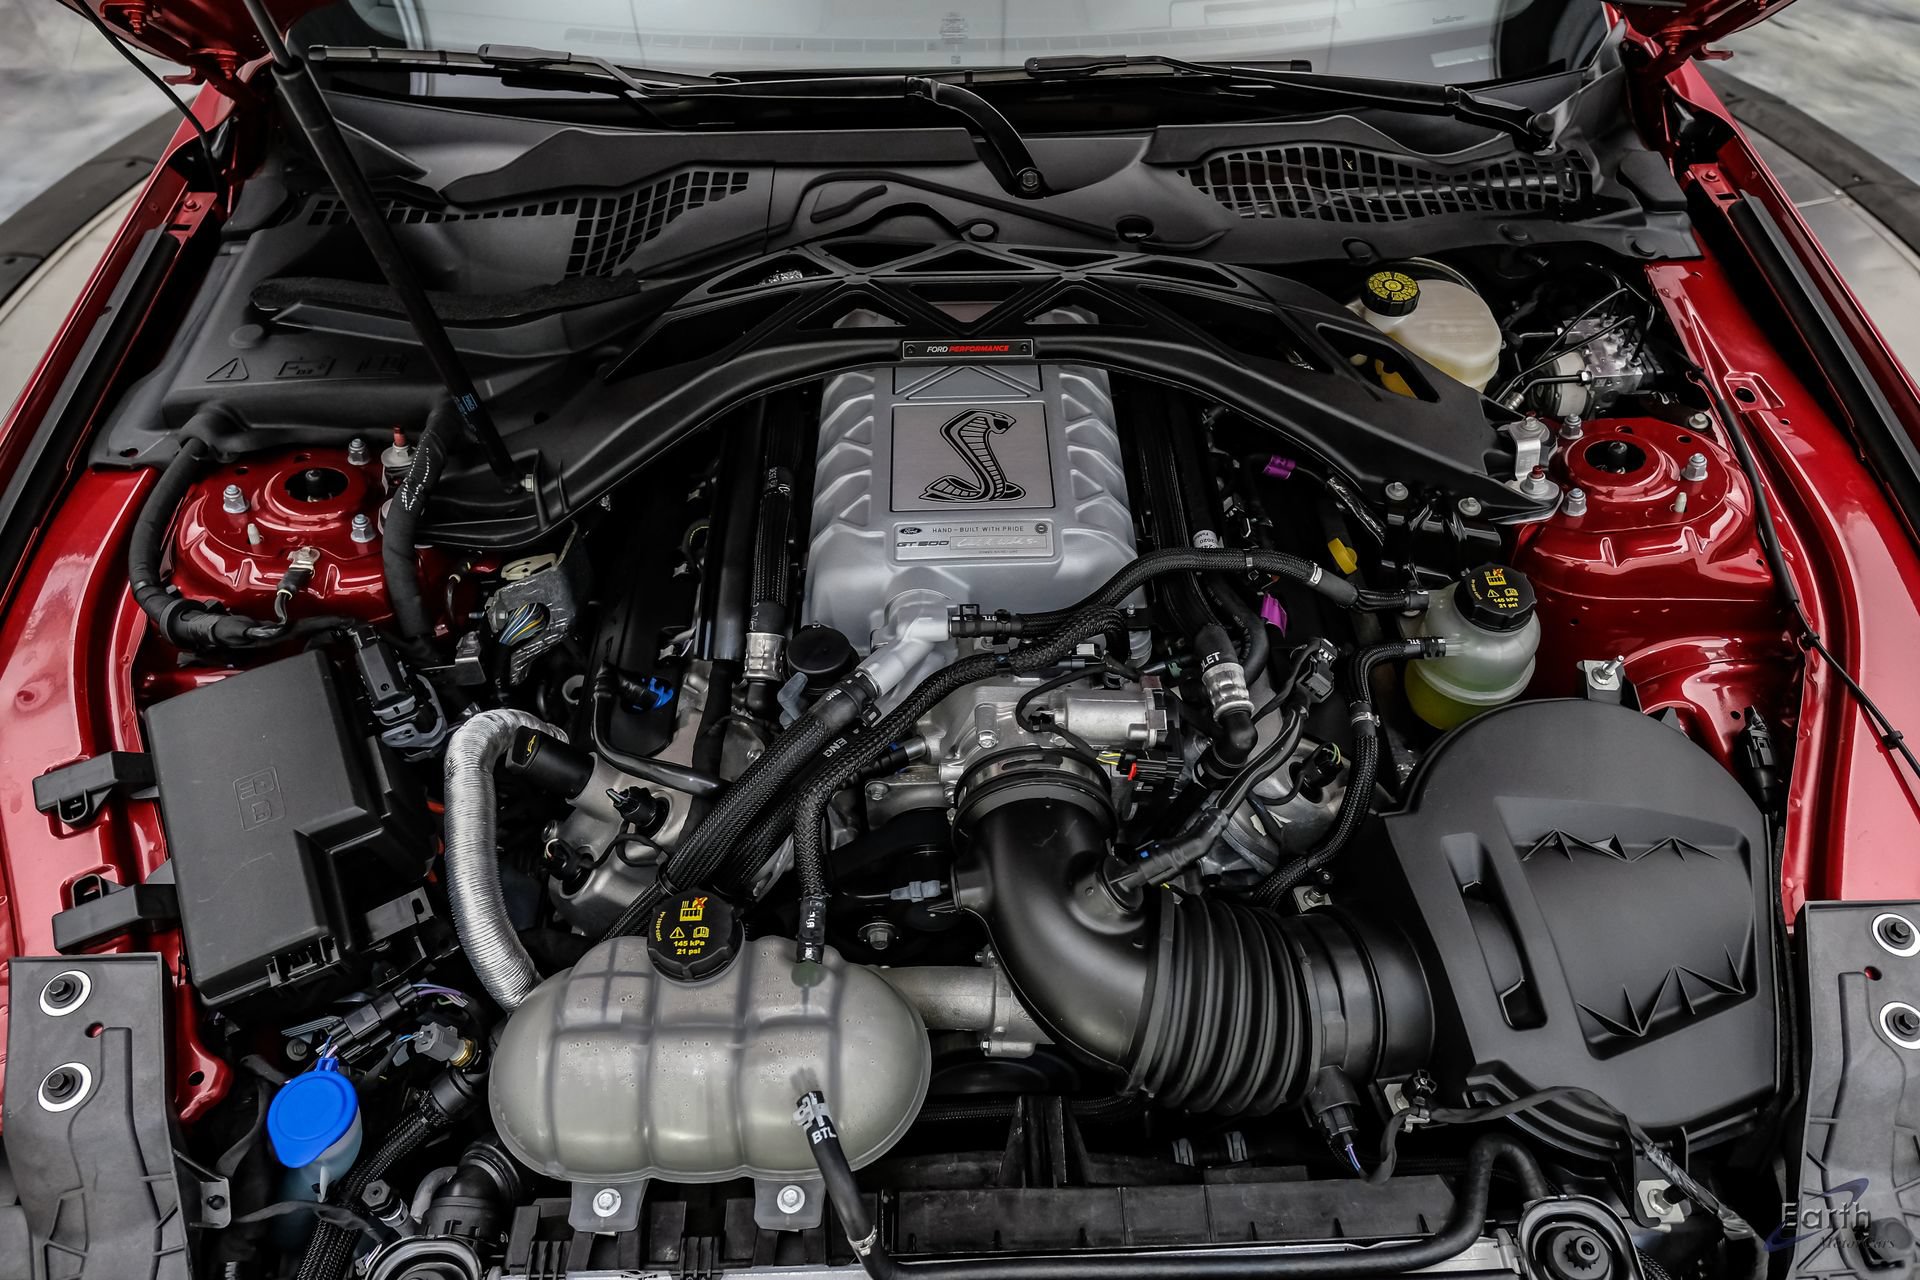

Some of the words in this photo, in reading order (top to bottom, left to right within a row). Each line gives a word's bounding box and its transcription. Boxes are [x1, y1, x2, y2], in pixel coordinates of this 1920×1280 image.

[926, 345, 948, 353] FORD
[948, 345, 1009, 353] PERFORMANCE
[896, 540, 950, 548] GT500
[822, 737, 848, 758] ENG
[688, 947, 701, 956] psi
[811, 1126, 837, 1145] BTL
